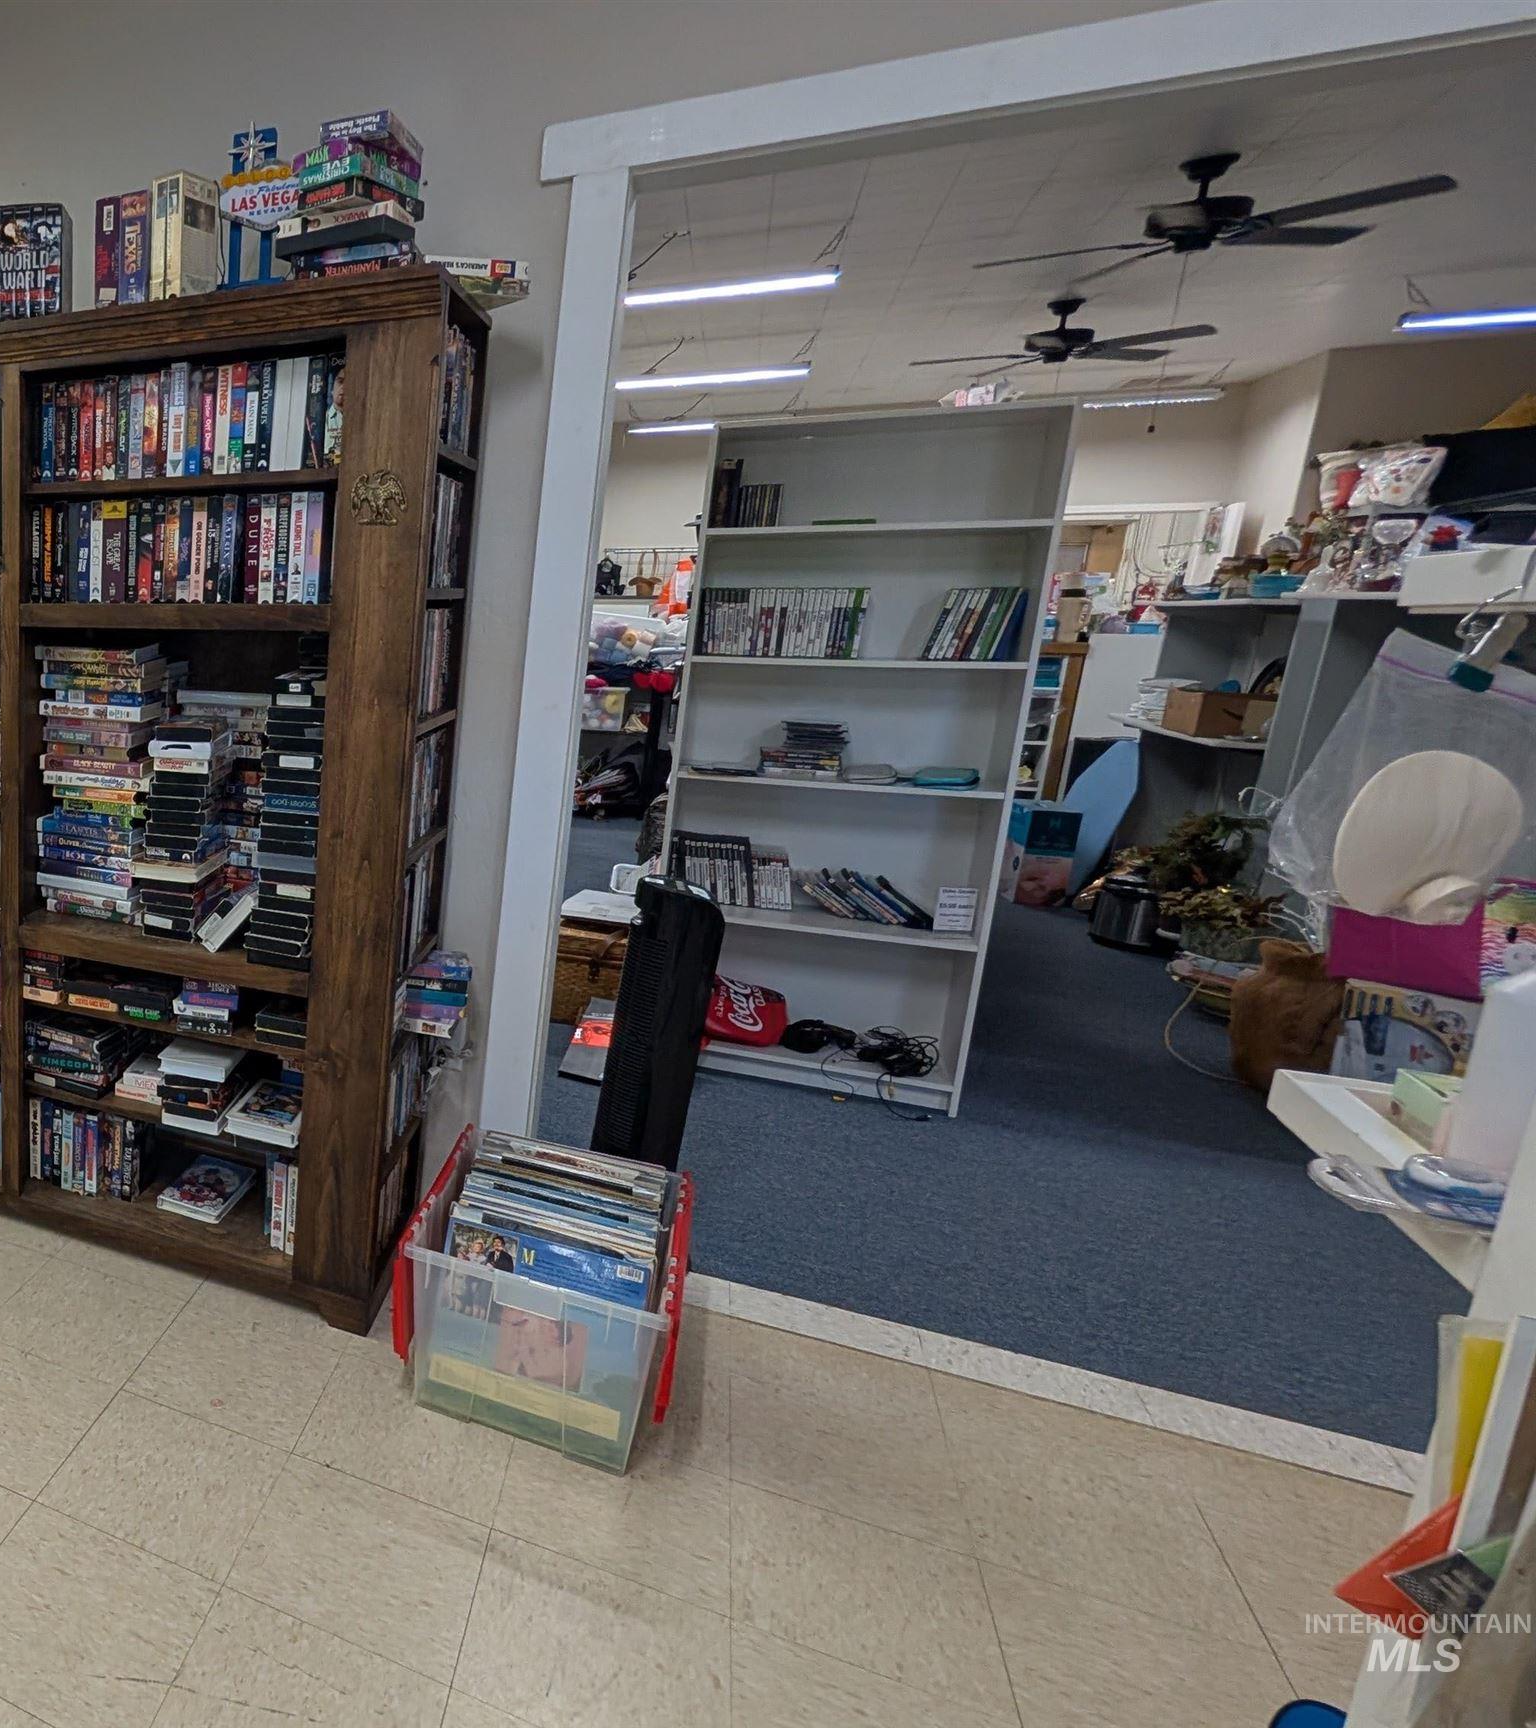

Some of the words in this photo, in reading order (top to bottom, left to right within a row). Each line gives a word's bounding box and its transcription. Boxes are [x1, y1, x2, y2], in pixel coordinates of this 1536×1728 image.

[303, 165, 350, 185] CHRISTMAS
[321, 157, 350, 171] EVE
[231, 196, 257, 213] LAS
[262, 189, 300, 209] VEGA
[248, 205, 291, 216] NEVADA
[125, 221, 140, 275] TEXAS
[0, 251, 49, 271] WORLD
[325, 260, 381, 277] MANHUNTER
[2, 270, 36, 290] WAR
[37, 270, 46, 288] II
[219, 368, 229, 416] WITNESS
[32, 511, 40, 558] GALLAGHER
[224, 516, 233, 560] MATRIX
[278, 507, 288, 551] INDEPENDENCE
[294, 510, 303, 542] WALKING
[92, 529, 101, 567] GHOST
[248, 515, 258, 566] DUNE
[262, 518, 272, 560] FROST
[113, 548, 121, 572] GREAT
[58, 837, 80, 847] OLIVER
[40, 1056, 89, 1069] TIMECOP
[123, 1162, 132, 1184] DRIVER
